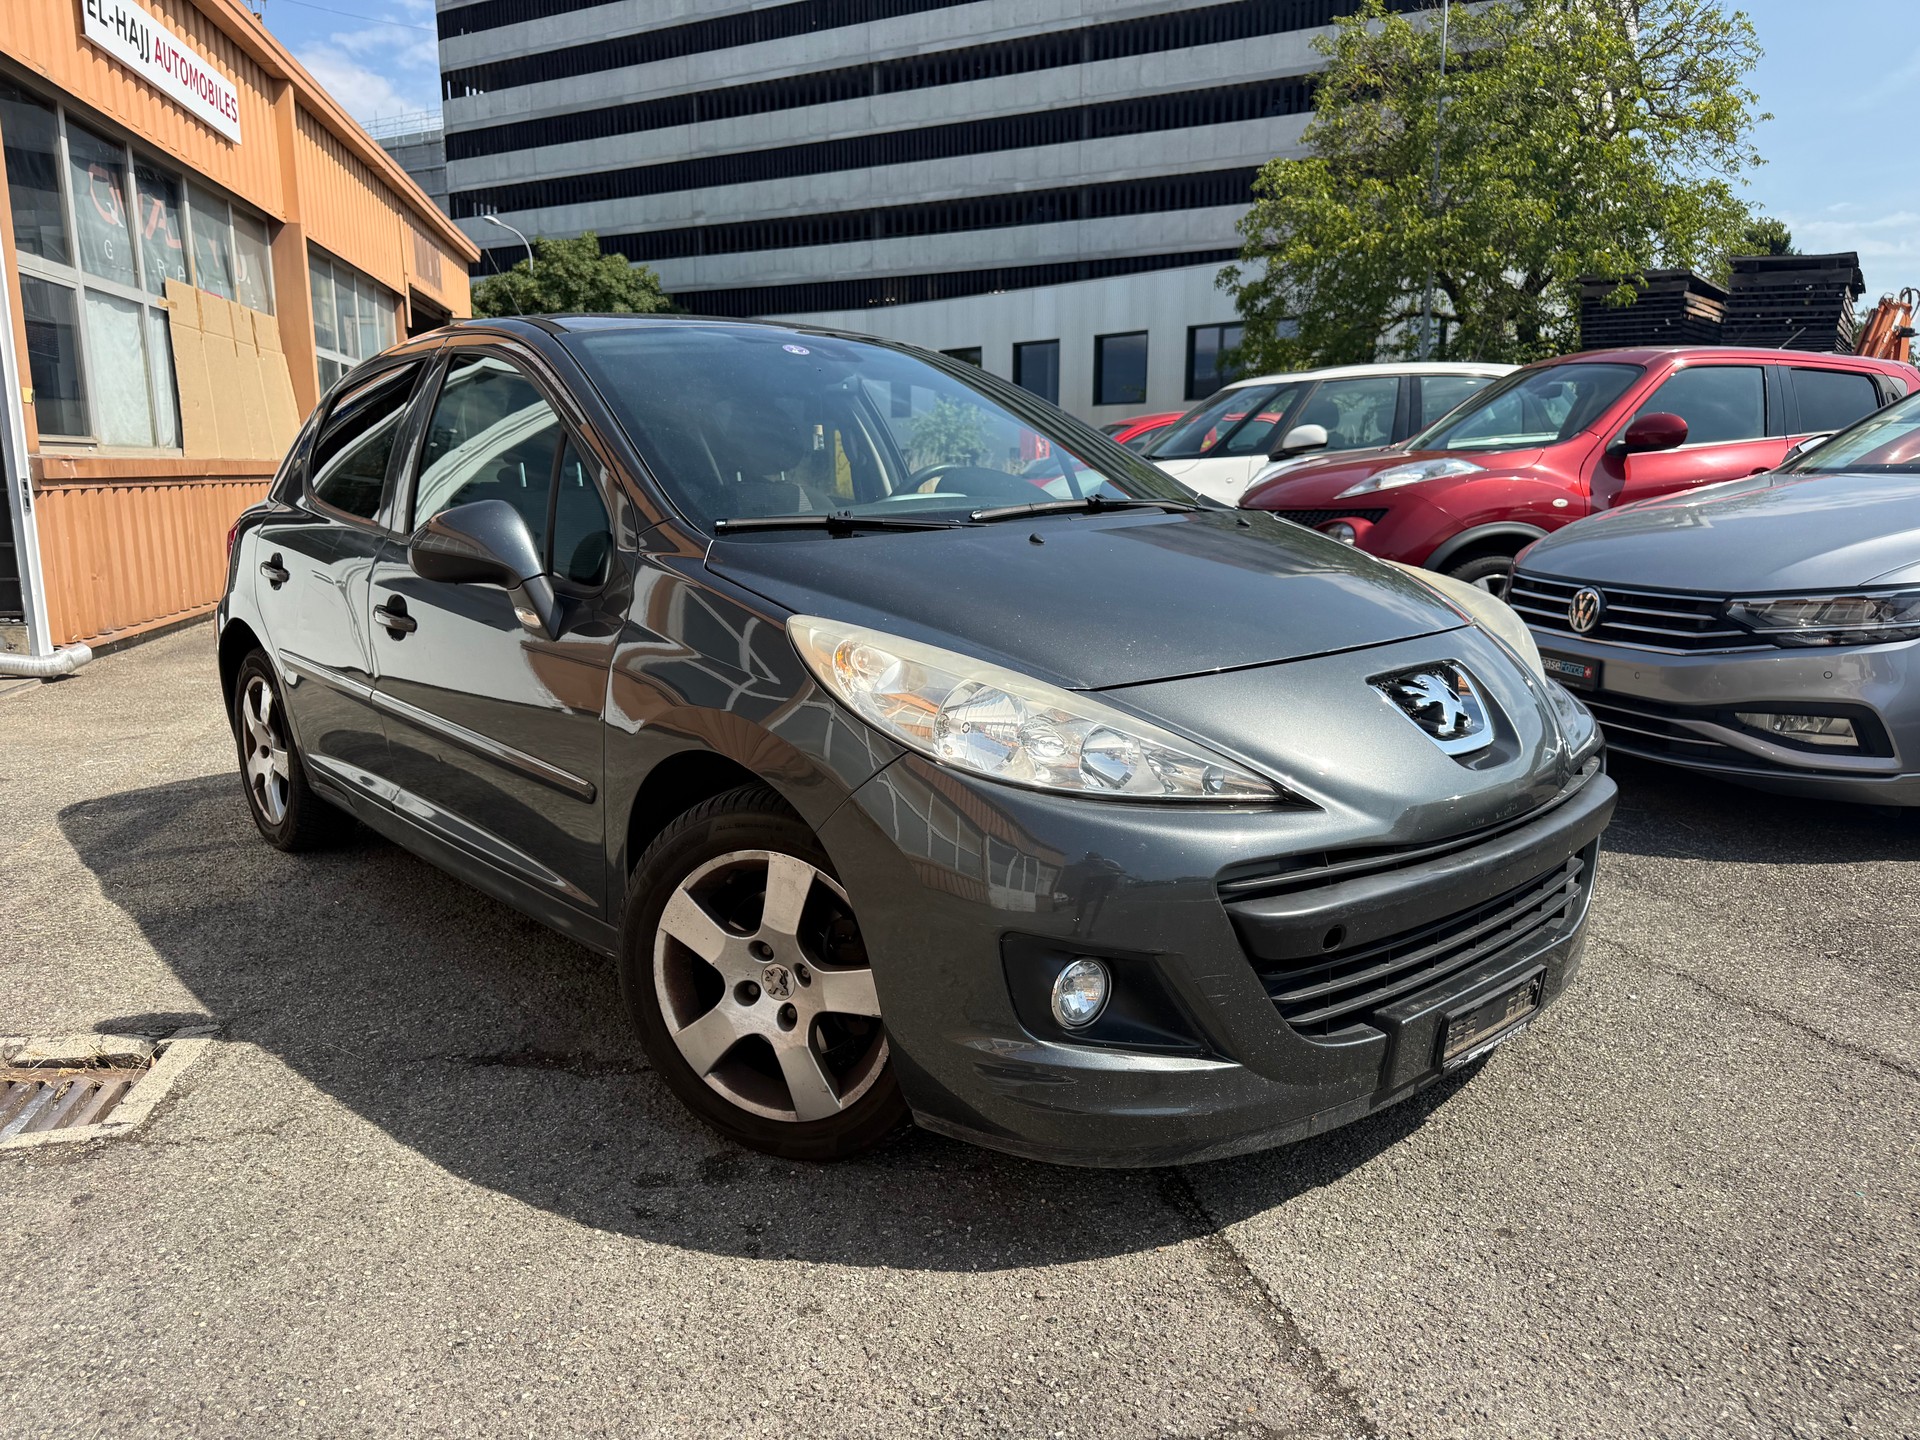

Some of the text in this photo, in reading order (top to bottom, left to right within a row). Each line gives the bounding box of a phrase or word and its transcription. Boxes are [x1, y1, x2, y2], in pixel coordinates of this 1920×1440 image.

[87, 0, 238, 124] EL-HAJJ AUTOMOBILES
[1541, 658, 1584, 675] easeForce
